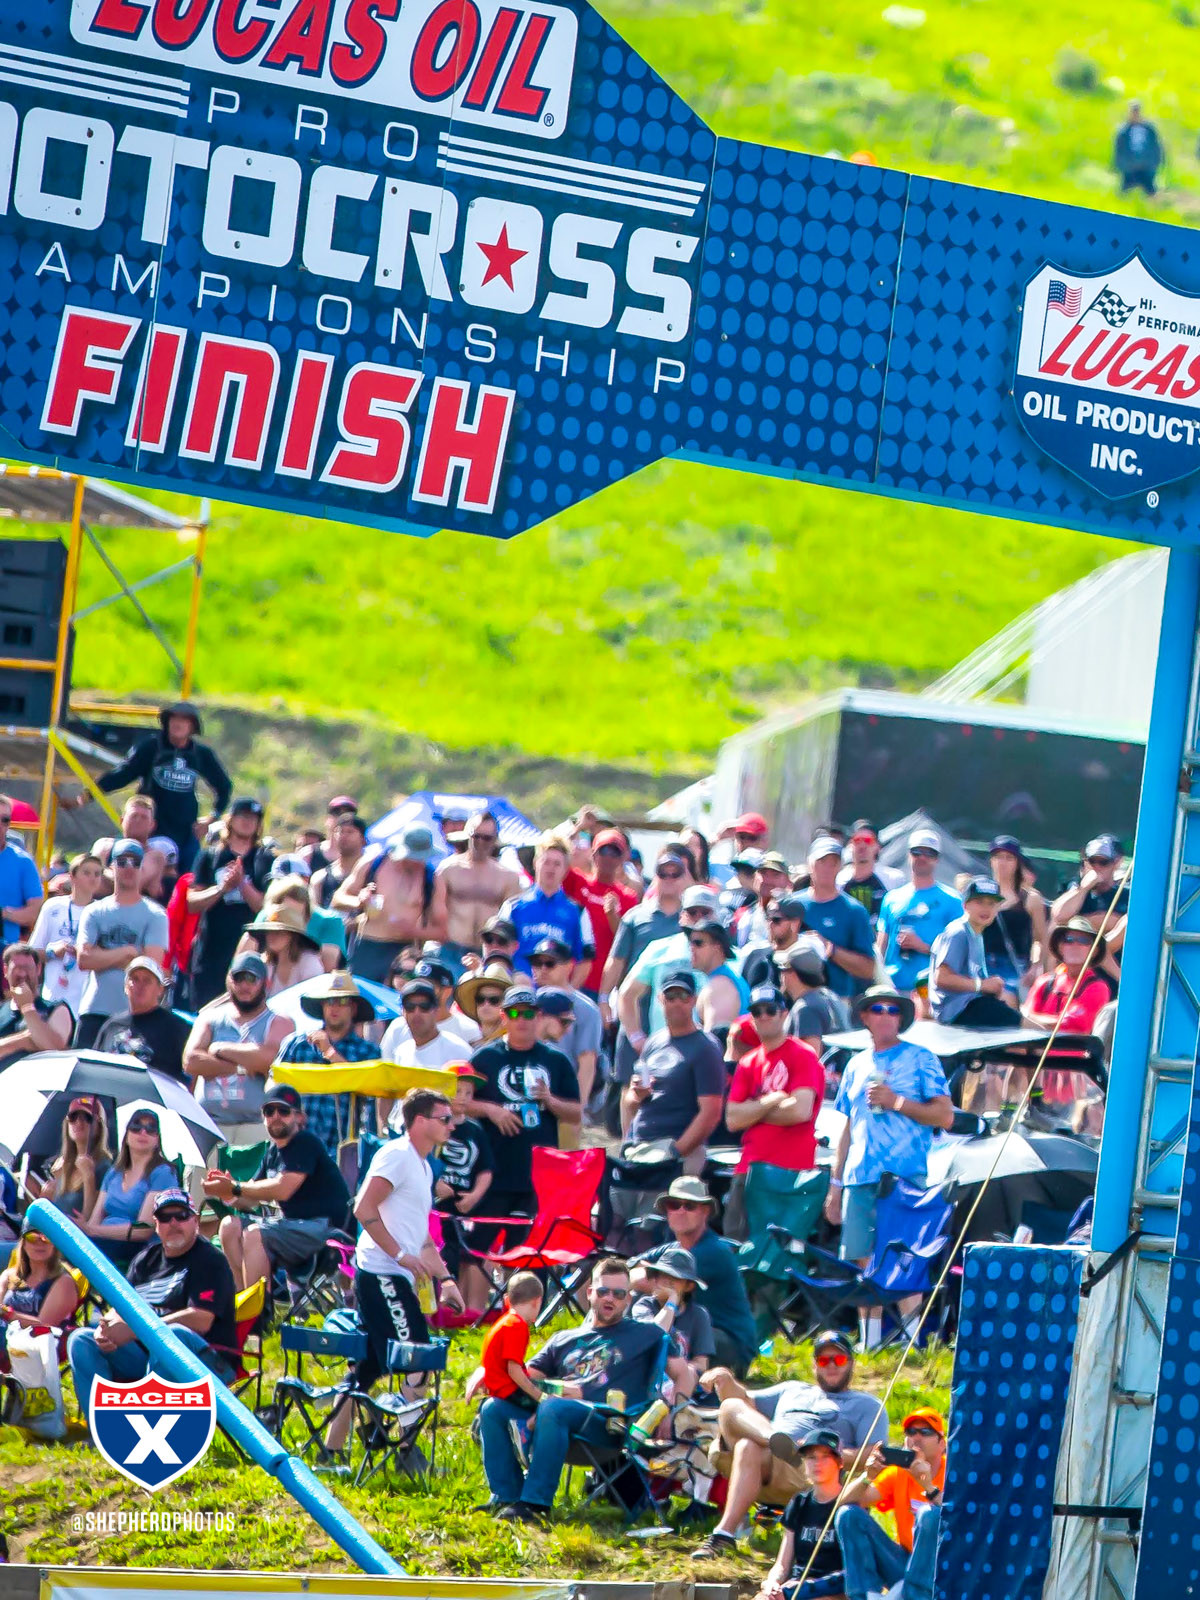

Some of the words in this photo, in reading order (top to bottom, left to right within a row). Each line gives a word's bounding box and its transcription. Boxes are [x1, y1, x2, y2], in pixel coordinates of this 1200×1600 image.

[410, 0, 552, 121] OIL
[207, 87, 419, 162] PRO
[0, 106, 699, 342] OTOCROSS
[35, 242, 686, 393] AMPIONSHIP
[39, 304, 516, 514] FINISH
[1022, 391, 1067, 422] OIL
[1090, 443, 1144, 477] INC.
